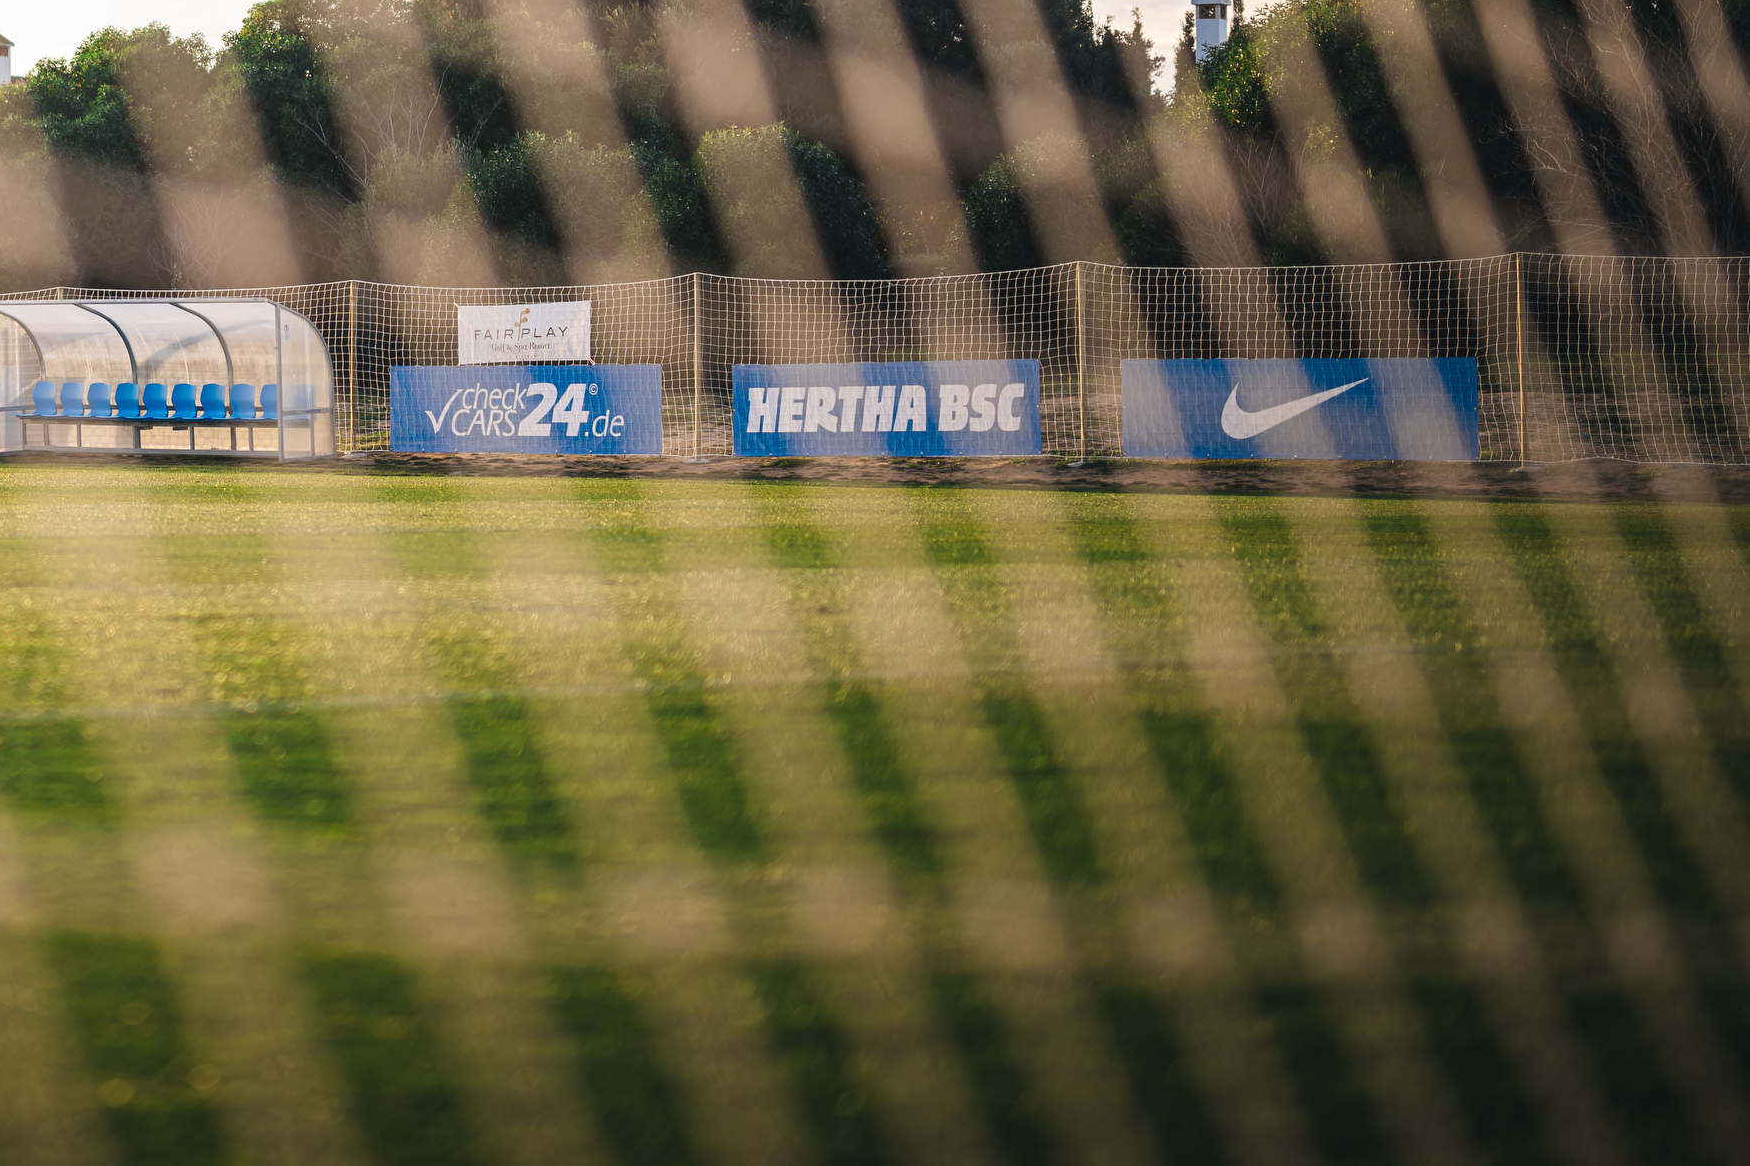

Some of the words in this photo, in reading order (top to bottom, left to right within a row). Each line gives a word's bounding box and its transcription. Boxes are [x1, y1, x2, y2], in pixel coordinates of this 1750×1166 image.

[529, 341, 550, 350] Resort
[462, 382, 528, 410] check
[746, 385, 927, 433] HERTHA
[938, 383, 1025, 432] BSC
[451, 409, 517, 437] CARS
